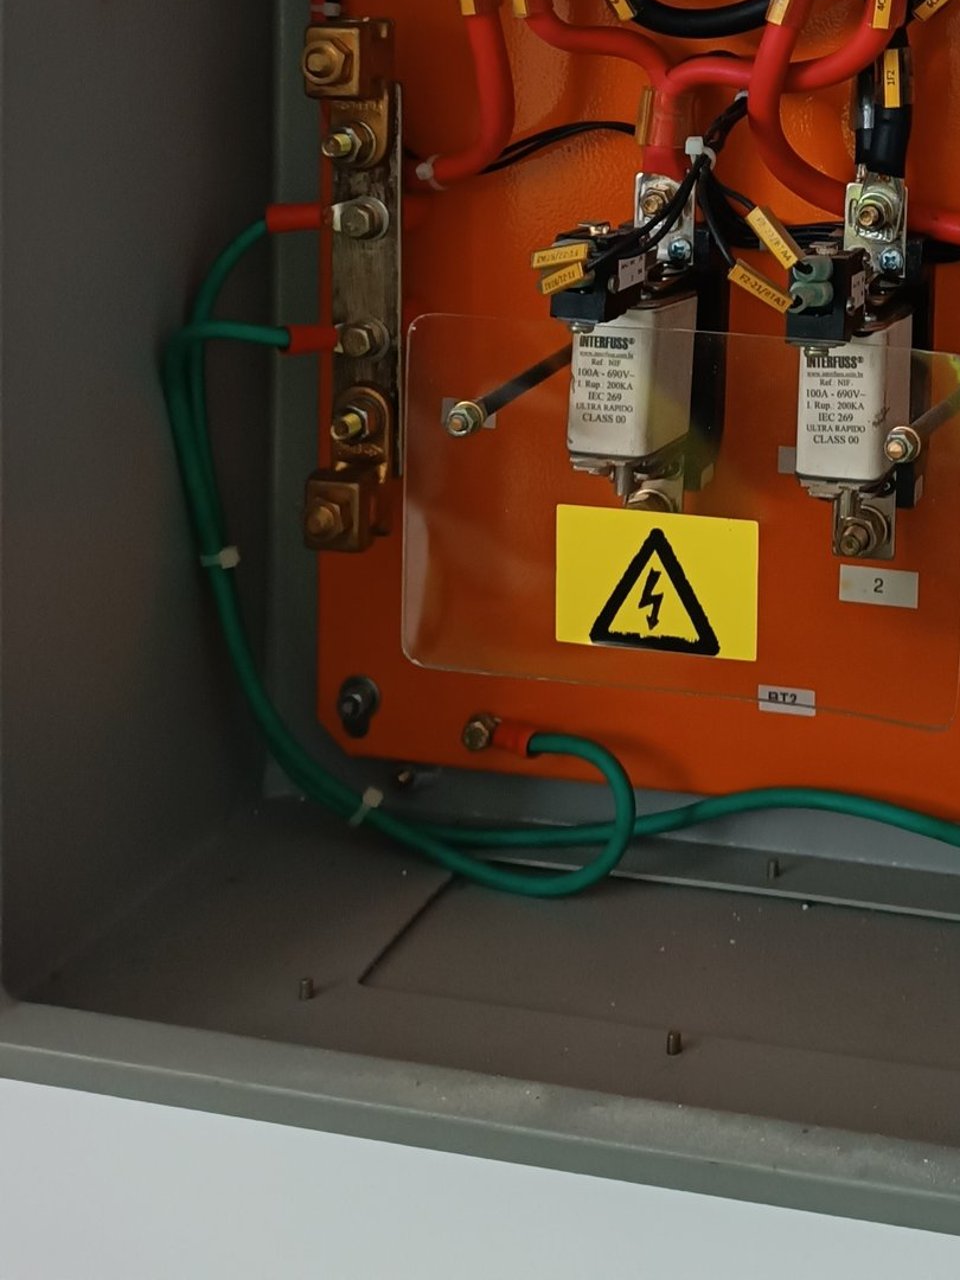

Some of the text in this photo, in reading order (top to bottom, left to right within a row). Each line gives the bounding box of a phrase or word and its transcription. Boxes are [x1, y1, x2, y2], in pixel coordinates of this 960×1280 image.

[887, 70, 896, 86] 1F2
[578, 368, 599, 377] 100A
[607, 381, 633, 390] 200KA
[588, 391, 622, 402] IEC 269
[806, 389, 828, 398] 100A
[576, 402, 633, 412] ULTRA RAPIDO
[837, 402, 864, 410] 200KA
[582, 413, 626, 424] CLASS 00
[818, 412, 853, 422] IEC 269
[806, 424, 866, 433] ULTRA RAPIDO
[813, 434, 859, 444] CLASS 00
[873, 578, 884, 593] 2
